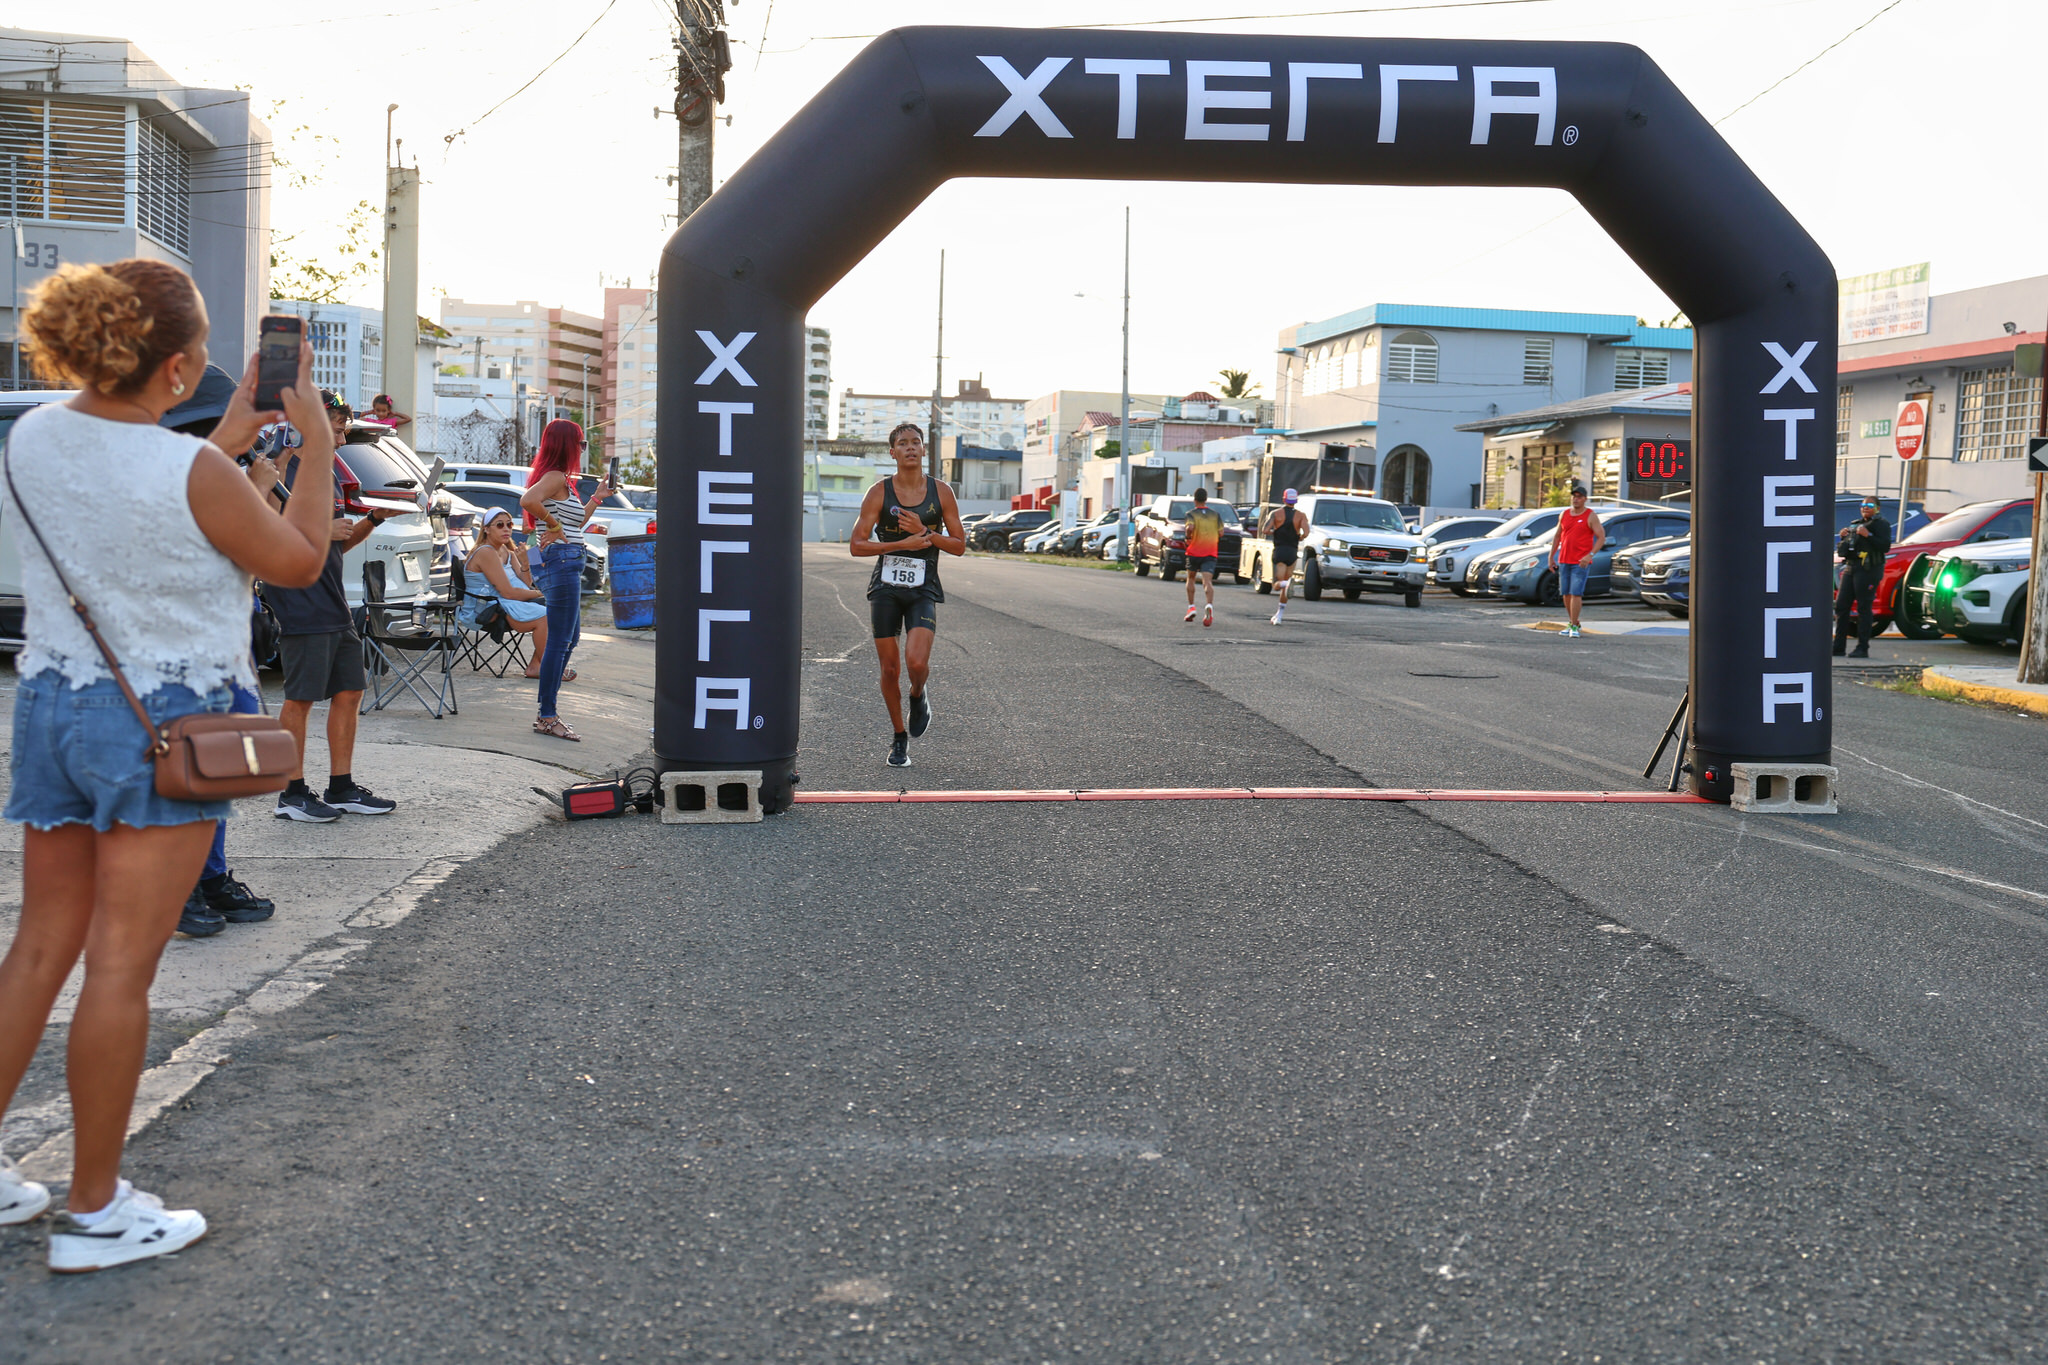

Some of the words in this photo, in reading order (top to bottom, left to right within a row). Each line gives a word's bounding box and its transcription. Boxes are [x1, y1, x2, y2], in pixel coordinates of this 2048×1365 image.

[1906, 411, 1917, 422] NO
[1875, 421, 1889, 435] 513
[1900, 438, 1918, 449] ENTRE
[1369, 550, 1391, 558] GMC
[892, 569, 916, 584] 158
